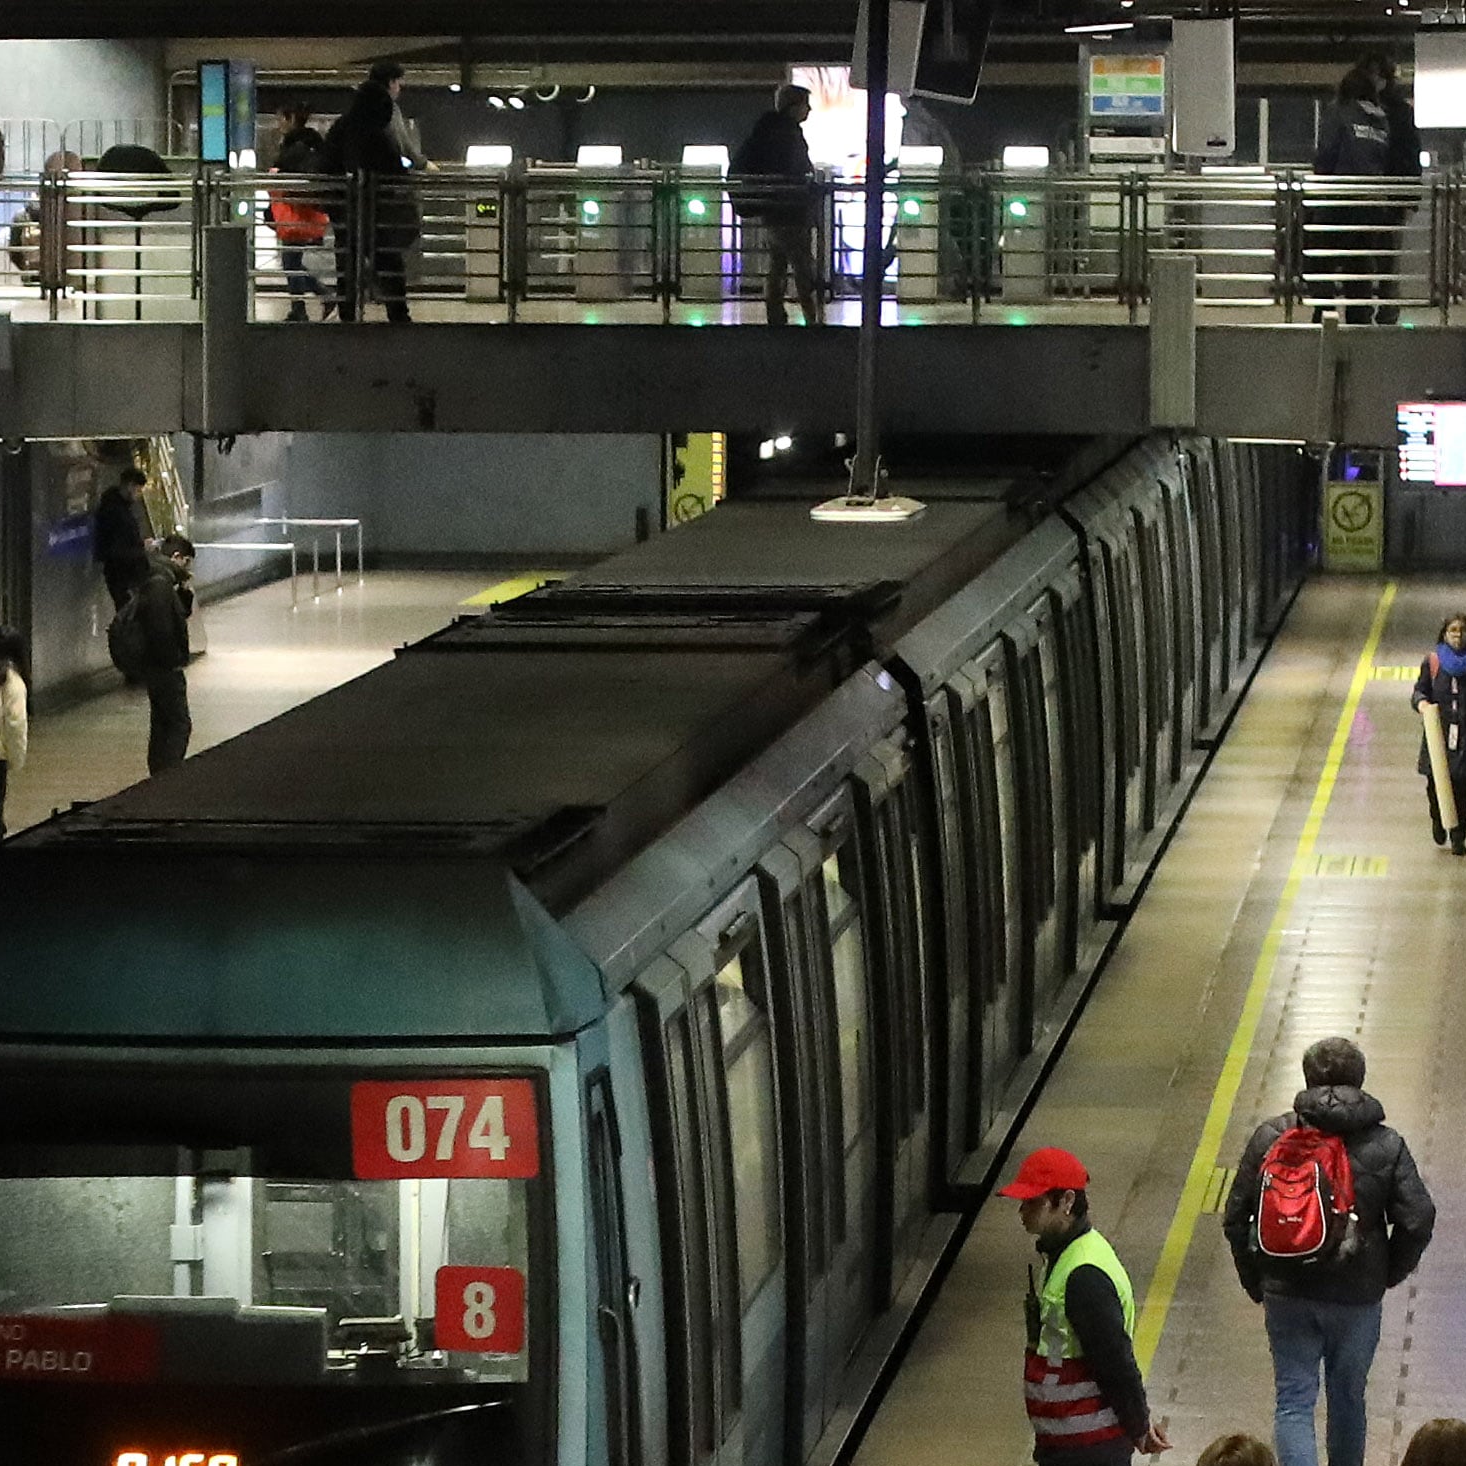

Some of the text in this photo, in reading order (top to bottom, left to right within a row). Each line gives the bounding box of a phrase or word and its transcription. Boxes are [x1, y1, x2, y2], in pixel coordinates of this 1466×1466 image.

[385, 1094, 511, 1162] 074
[462, 1281, 496, 1339] 8
[5, 1350, 93, 1373] PABLO
